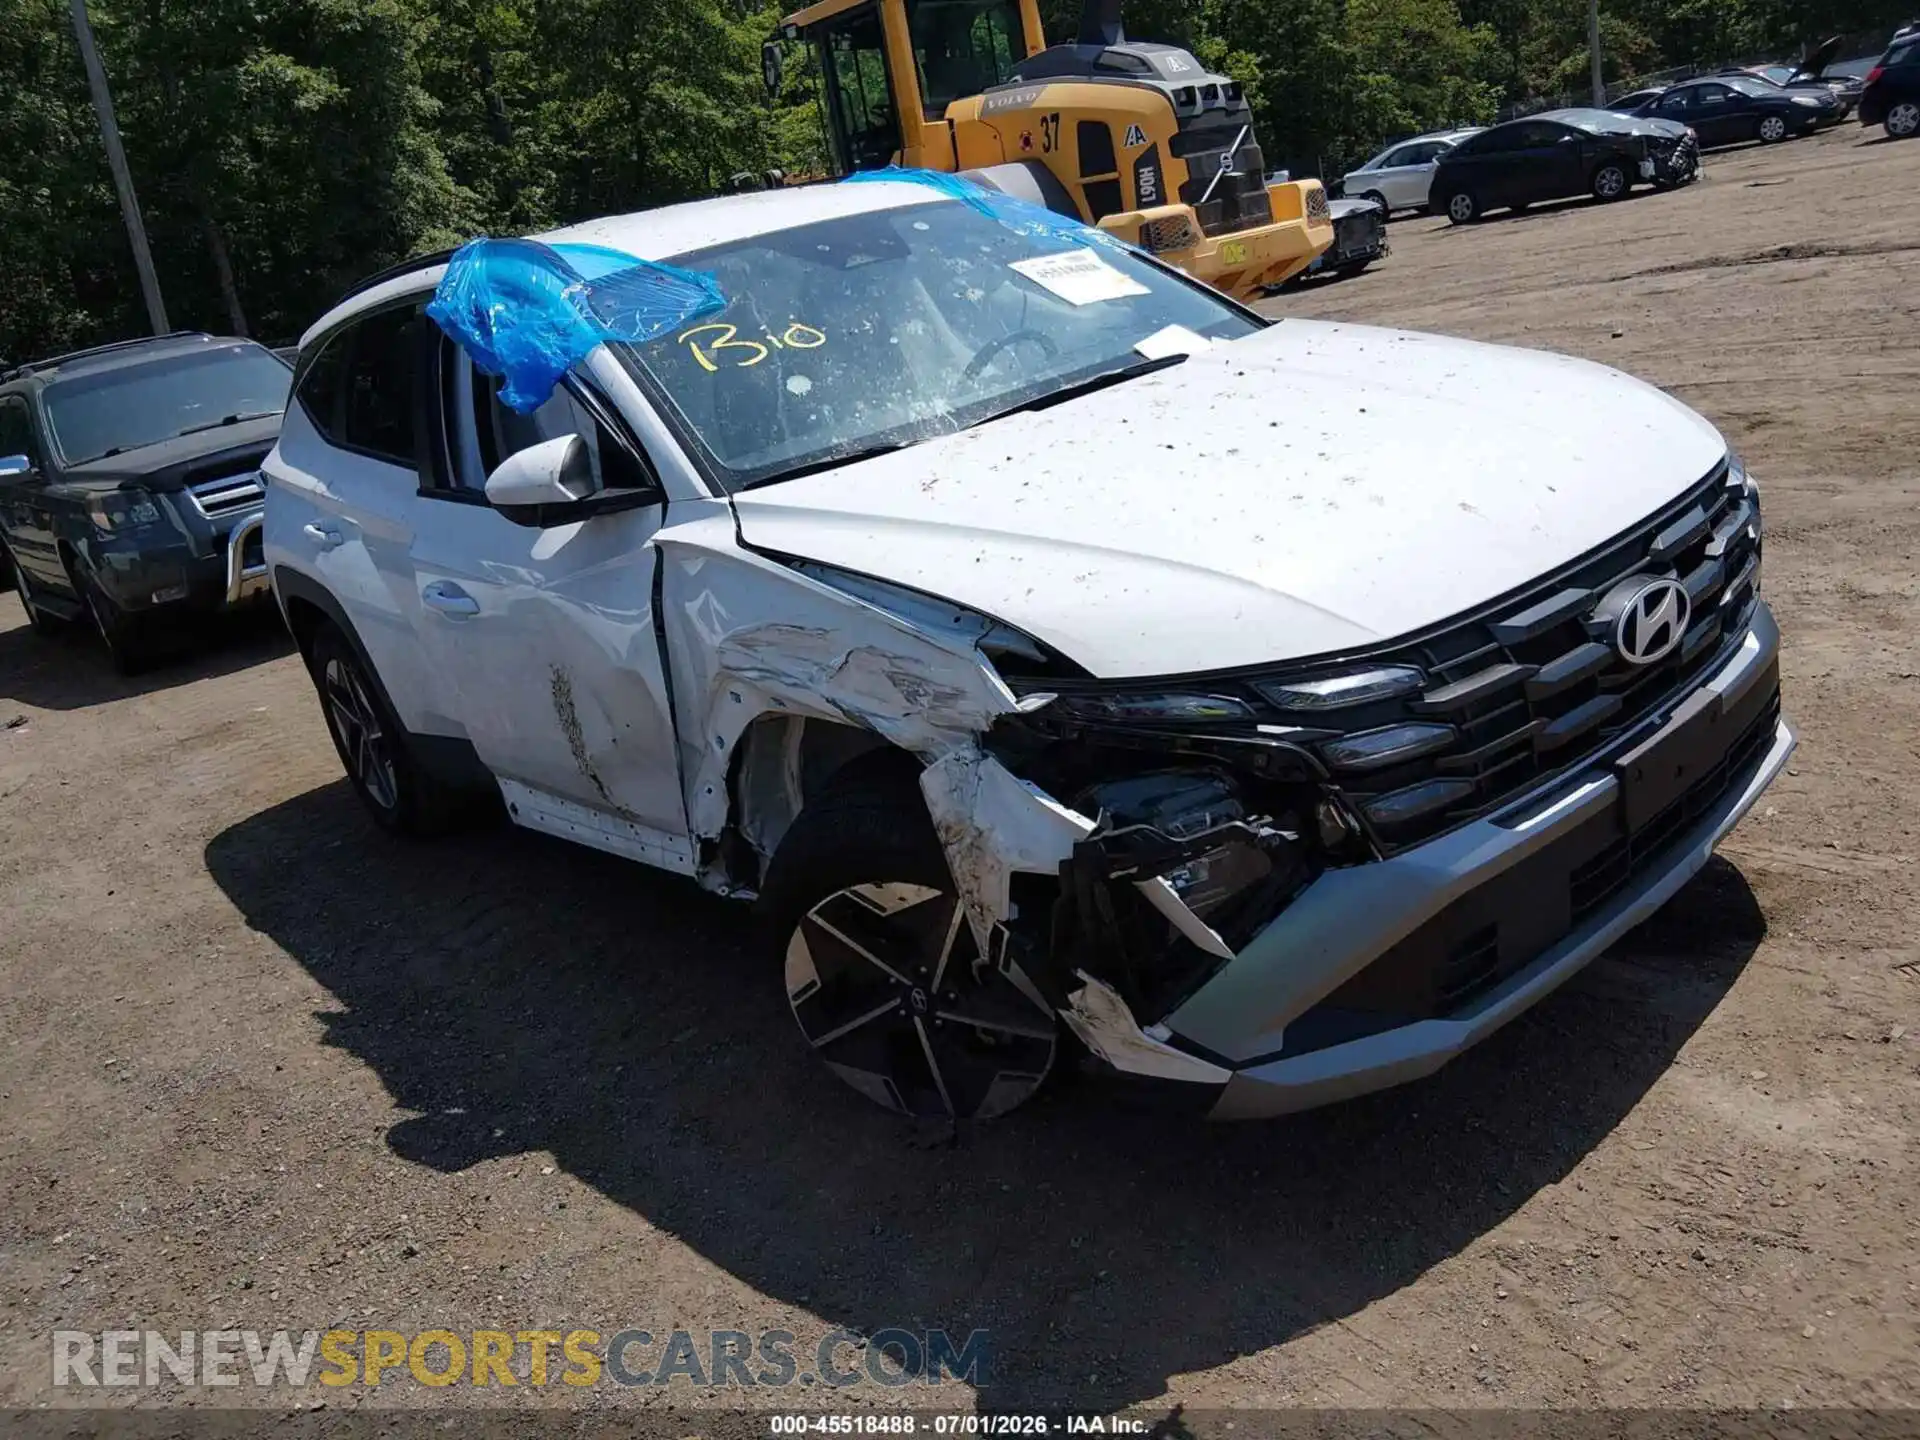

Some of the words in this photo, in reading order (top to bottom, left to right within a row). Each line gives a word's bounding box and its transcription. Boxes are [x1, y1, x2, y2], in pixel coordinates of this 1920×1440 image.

[987, 92, 1037, 109] VOLVO
[1040, 112, 1060, 154] 37
[1138, 166, 1157, 202] L90H
